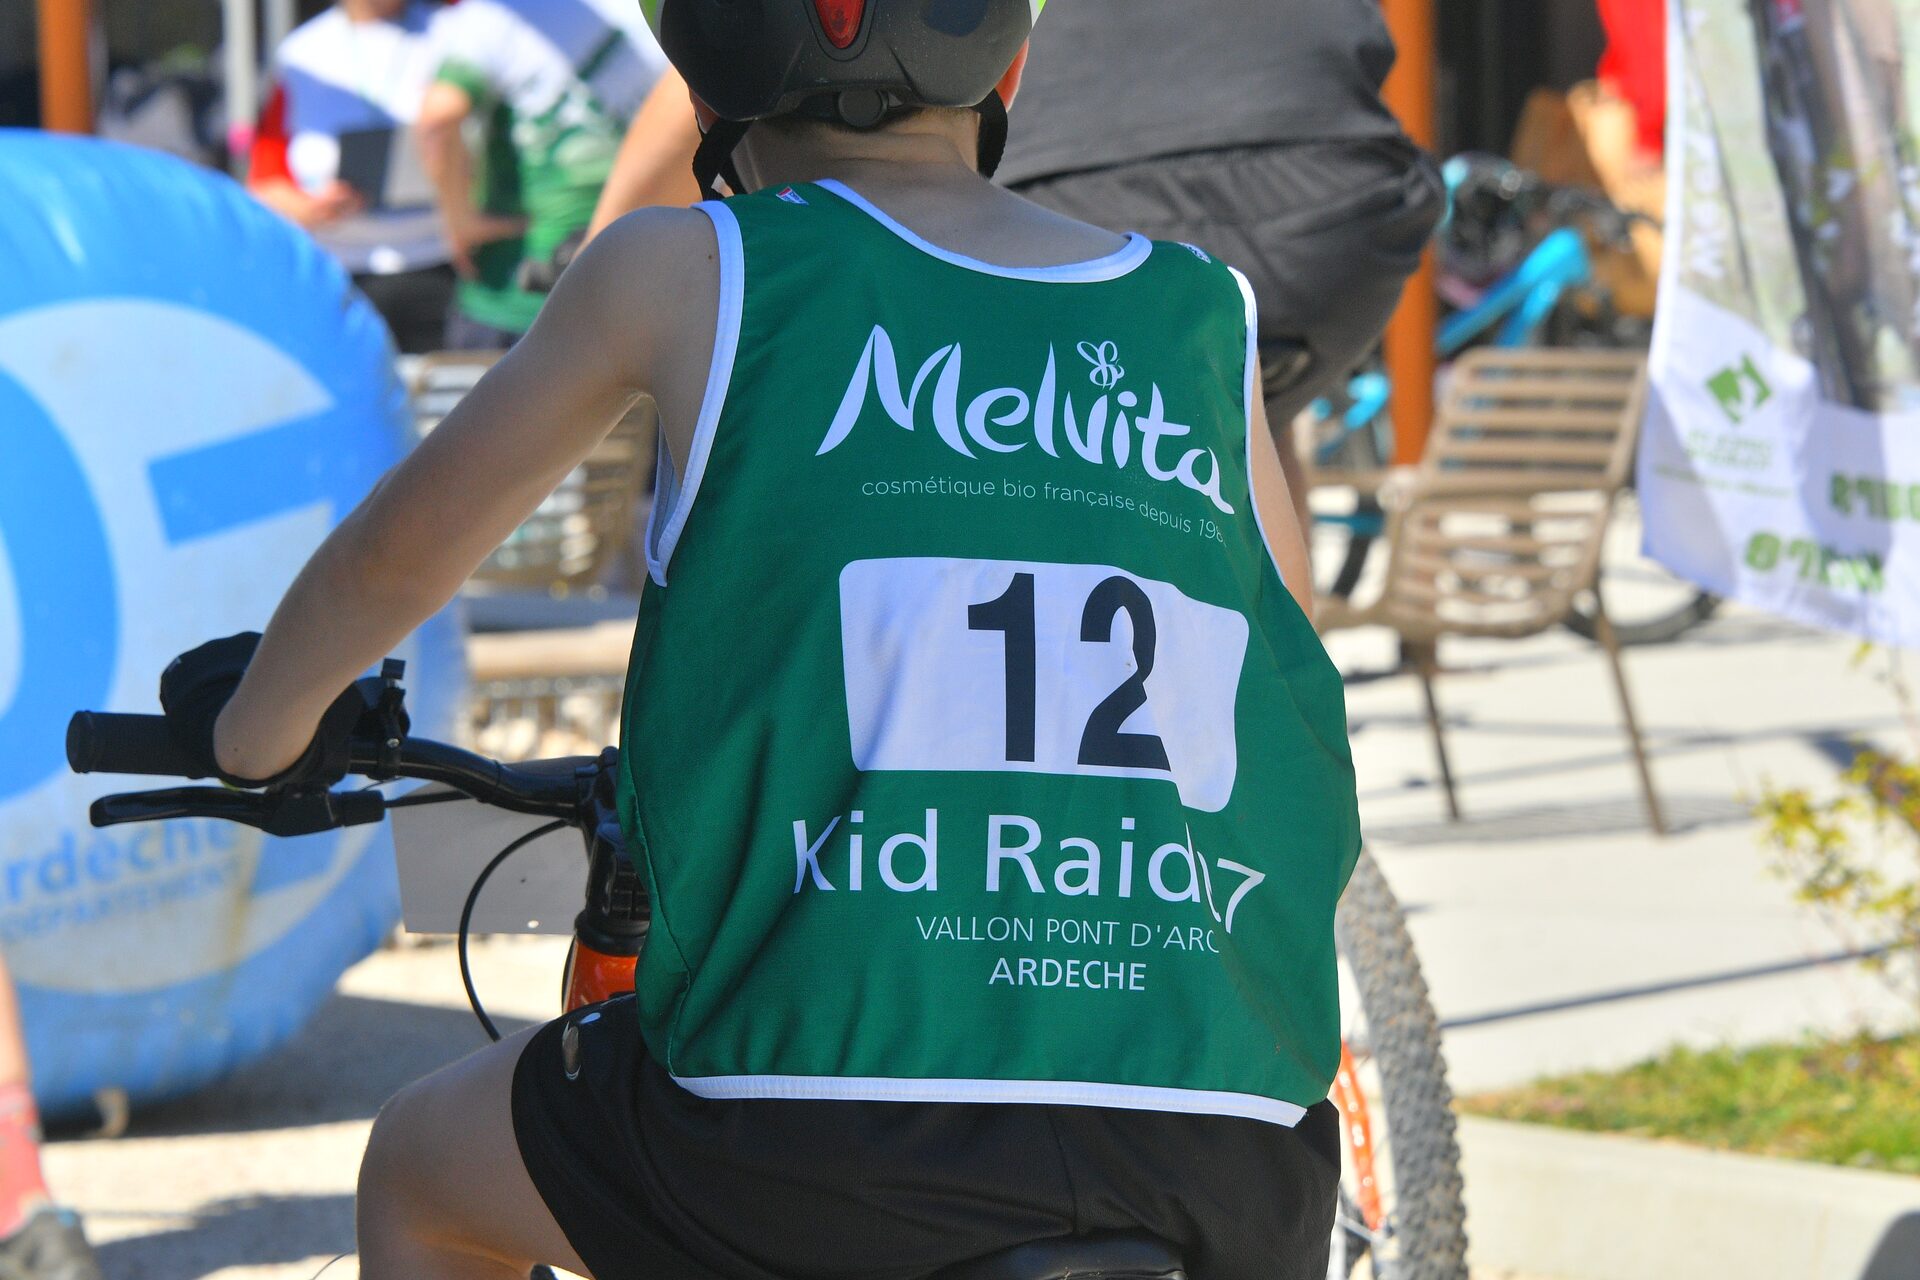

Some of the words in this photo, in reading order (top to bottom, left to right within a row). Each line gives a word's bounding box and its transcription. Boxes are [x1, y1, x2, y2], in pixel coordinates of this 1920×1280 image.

[816, 324, 1235, 515] Melvita
[862, 476, 996, 498] cosmétique
[1003, 478, 1036, 498] bio
[1044, 482, 1135, 511] française
[1139, 501, 1192, 533] depuis
[967, 572, 1171, 772] 12
[793, 808, 938, 894] Kid
[986, 814, 1201, 903] Raid
[916, 916, 1033, 942] VALLON
[1046, 918, 1120, 945] PONT
[1131, 923, 1220, 954] D'ARC
[988, 957, 1147, 991] ARDECHE
